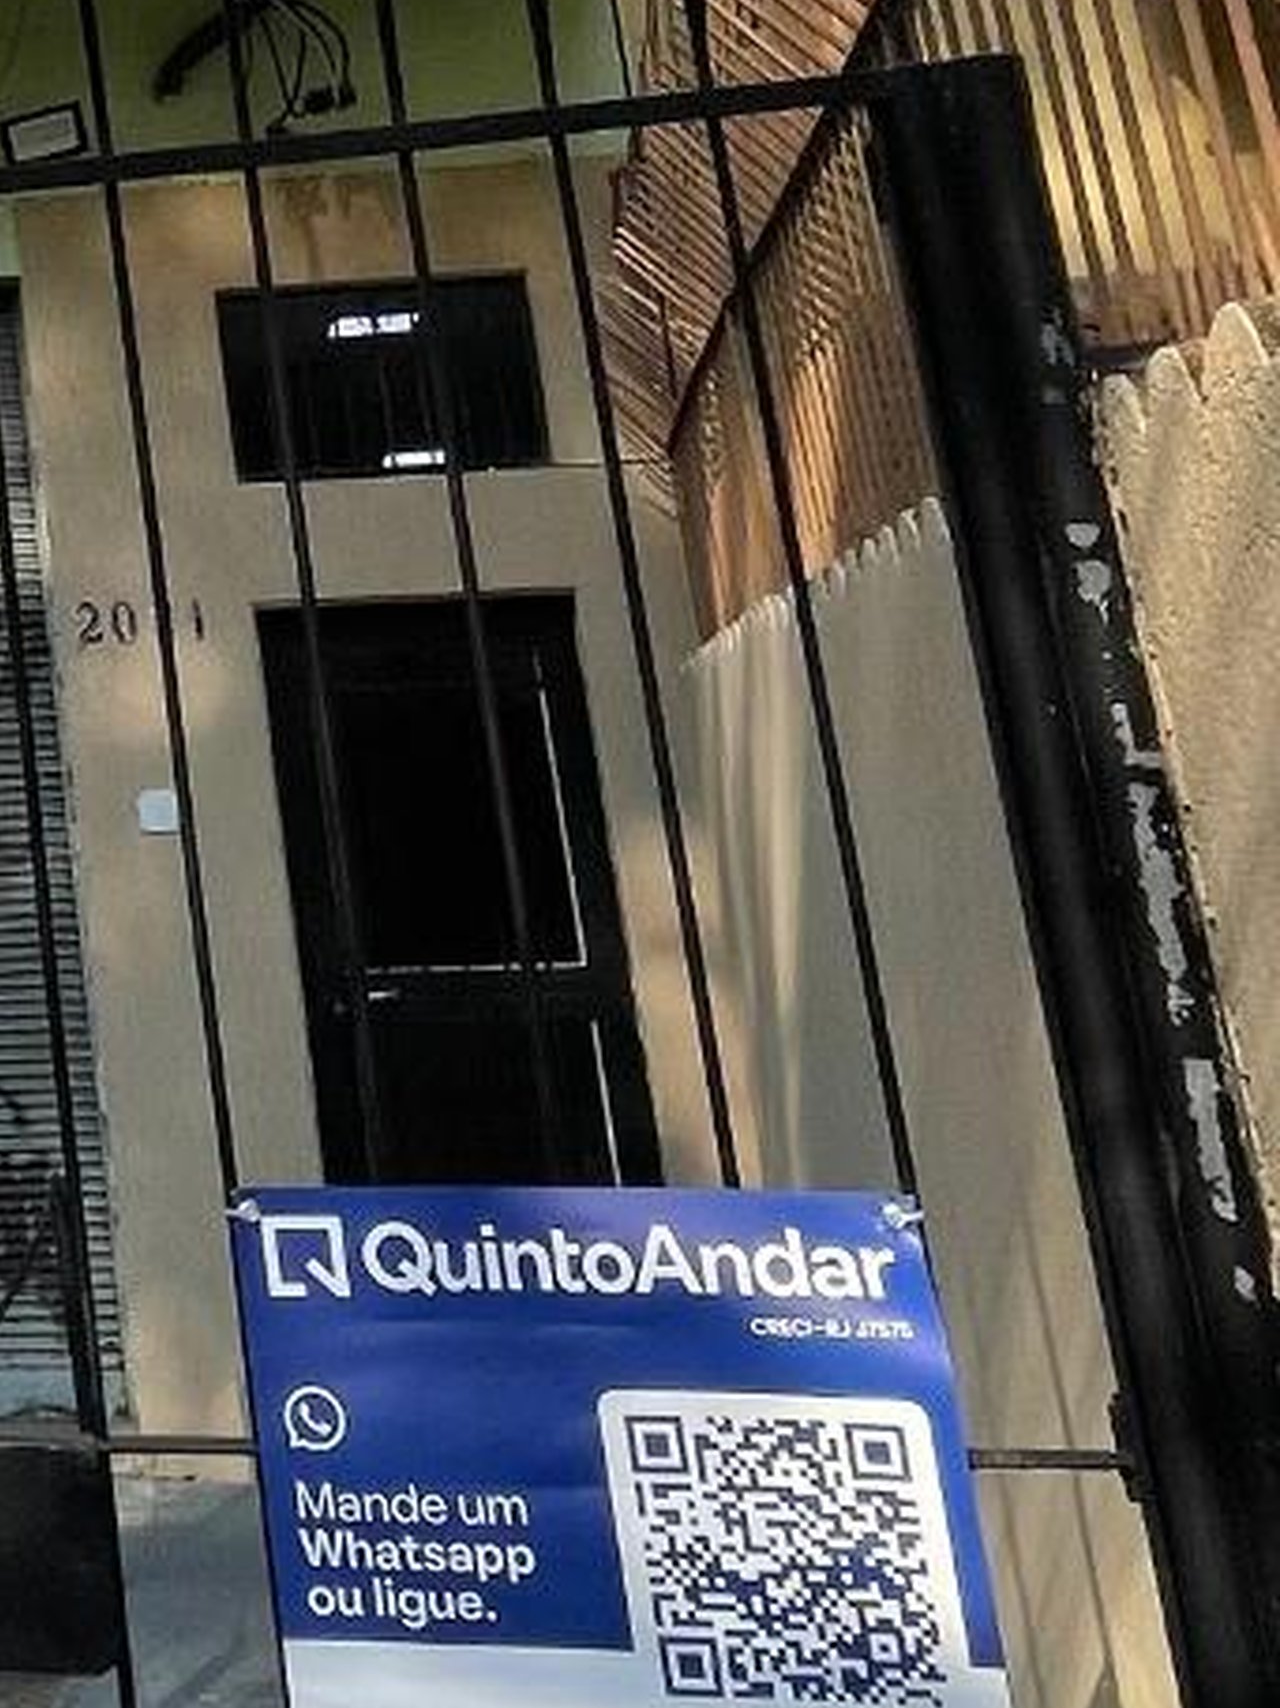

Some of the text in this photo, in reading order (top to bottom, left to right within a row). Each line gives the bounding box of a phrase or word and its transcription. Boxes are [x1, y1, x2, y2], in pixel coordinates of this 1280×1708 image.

[75, 599, 205, 647] 201
[362, 1221, 895, 1299] QuintoAndar
[296, 1481, 529, 1527] Mande um
[299, 1529, 536, 1583] Whatsapp
[308, 1577, 498, 1629] ou ligue.
